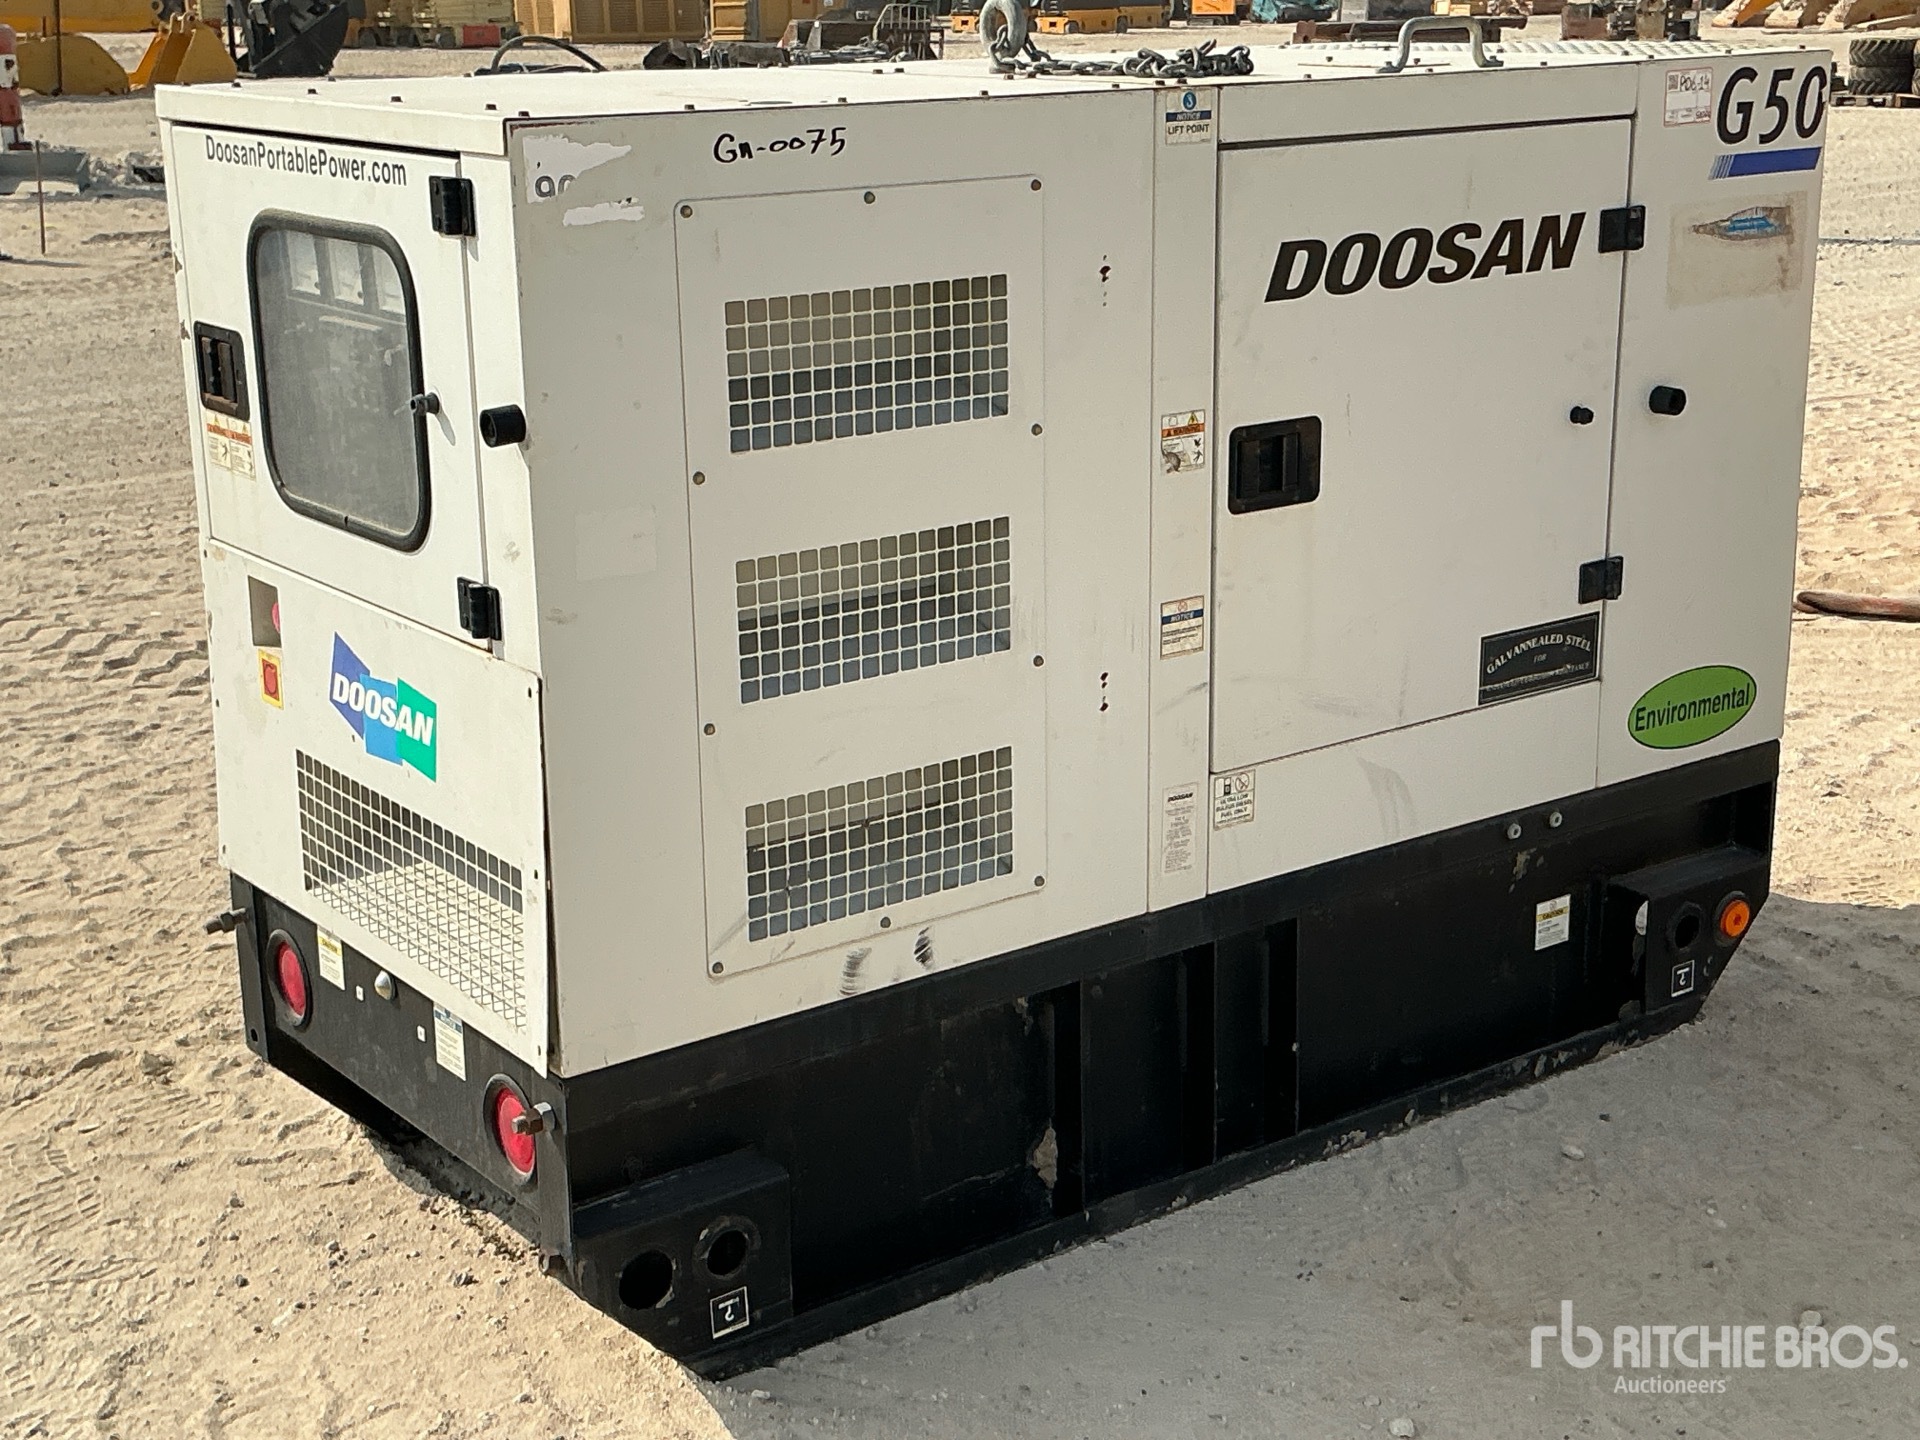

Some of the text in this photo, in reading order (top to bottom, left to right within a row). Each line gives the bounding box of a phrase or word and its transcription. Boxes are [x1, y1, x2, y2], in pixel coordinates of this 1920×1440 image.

[1167, 124, 1210, 135] LIFT POINT
[1176, 112, 1201, 121] NOTICE
[1717, 66, 1828, 145] G50
[205, 134, 407, 186] DoosanPortablePower.com
[1264, 212, 1587, 303] DOOSAN
[1486, 633, 1591, 674] GALVANNEALED STEEL
[1533, 654, 1547, 664] FOR
[332, 672, 434, 747] DOOSAN
[1634, 682, 1751, 732] Environmental
